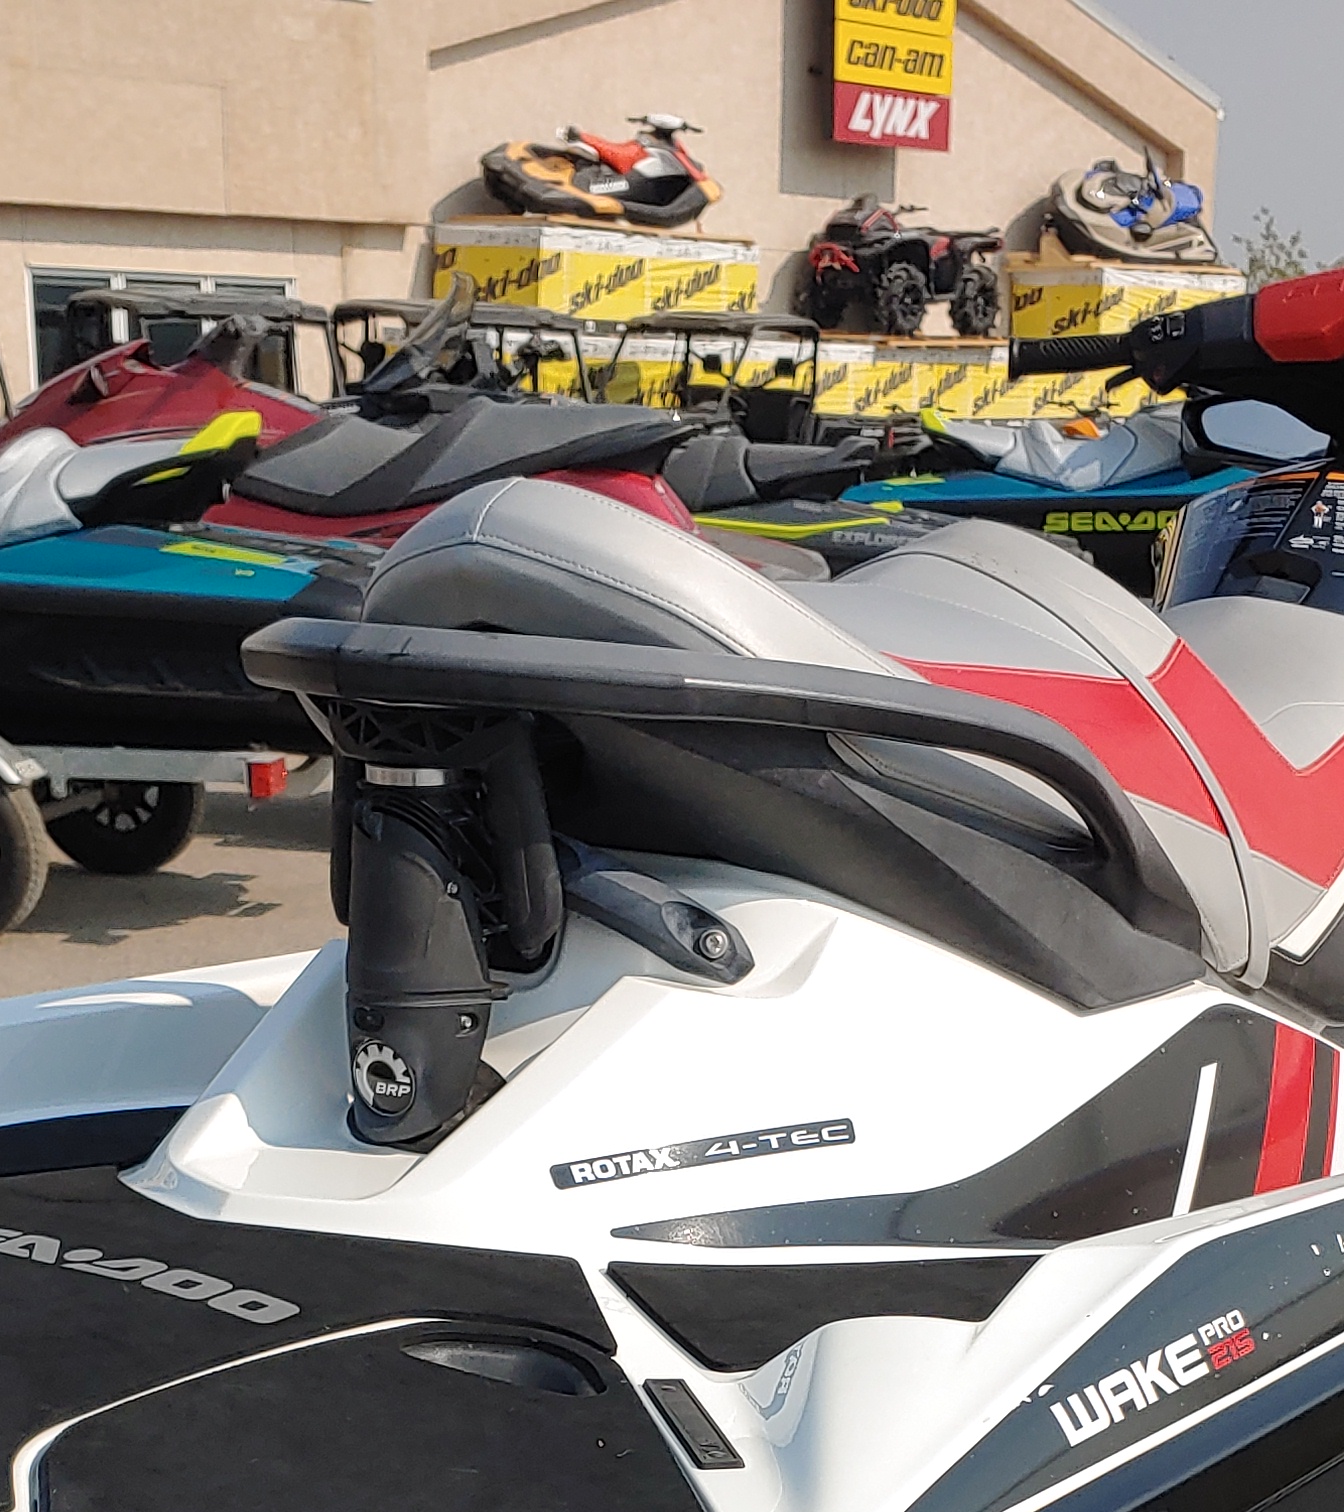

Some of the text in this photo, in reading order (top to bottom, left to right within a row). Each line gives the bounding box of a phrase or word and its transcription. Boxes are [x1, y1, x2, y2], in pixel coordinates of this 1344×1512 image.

[849, 0, 943, 21] -doo
[846, 39, 945, 79] can-am
[847, 91, 941, 141] LYNX
[376, 1081, 411, 1098] BRP
[569, 1124, 850, 1184] ROTAX 4-TEC
[1197, 1309, 1246, 1346] PRO
[1207, 1327, 1256, 1371] 215
[1049, 1333, 1210, 1448] WAKE
